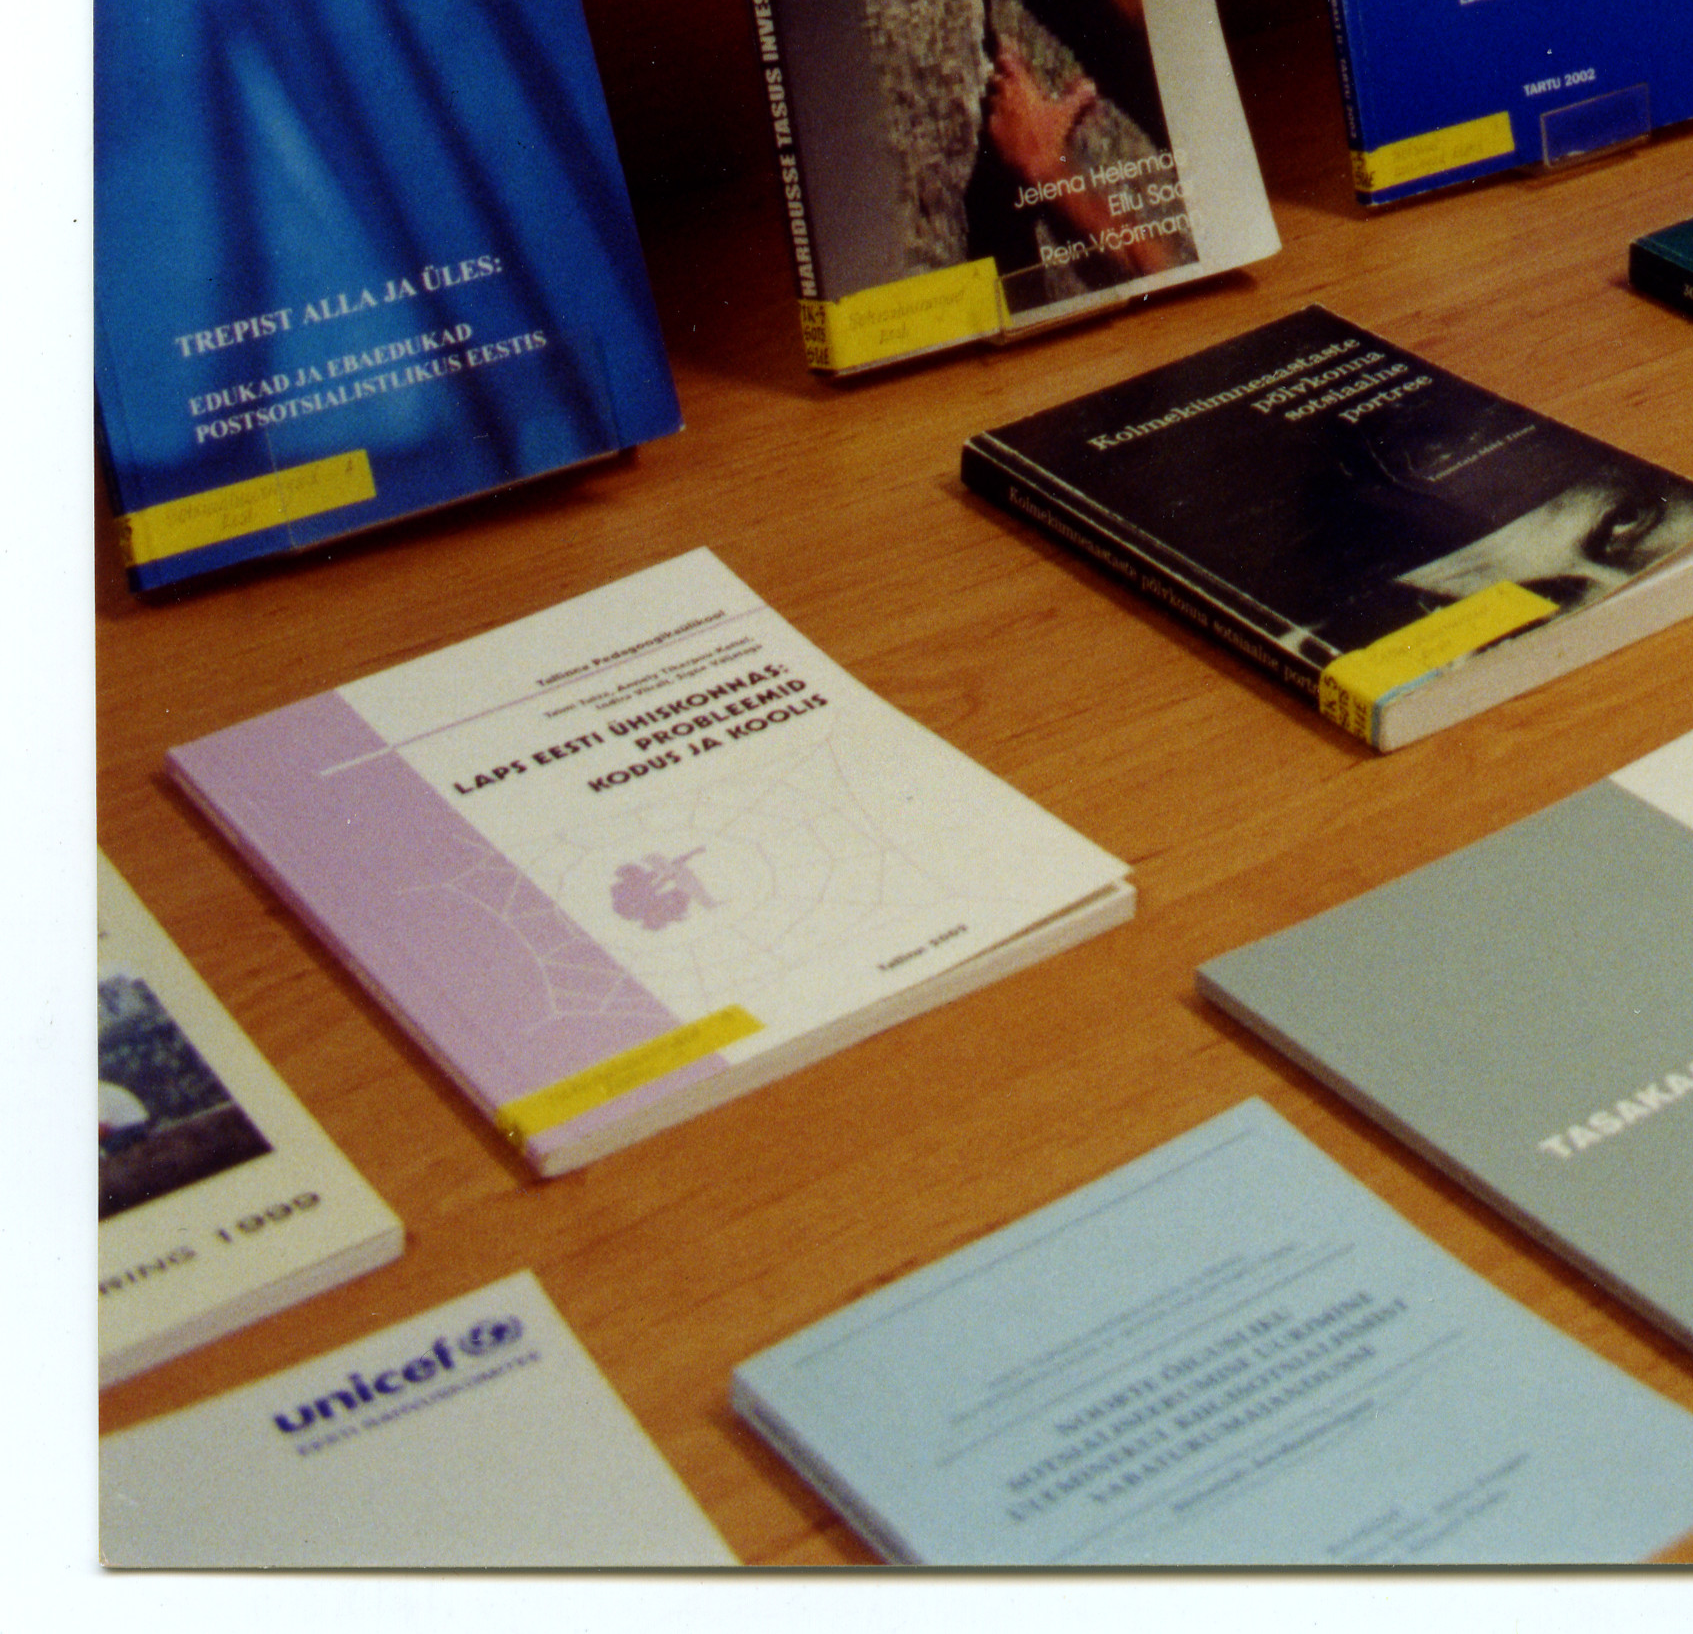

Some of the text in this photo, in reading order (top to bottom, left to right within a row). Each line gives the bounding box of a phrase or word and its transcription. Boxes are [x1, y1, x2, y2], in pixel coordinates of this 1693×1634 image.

[763, 67, 792, 149] TASUS
[1522, 67, 1597, 98] TARTU 2002
[778, 151, 817, 299] HARIDUSSE
[1013, 174, 1086, 209] Jelena
[1107, 188, 1144, 217] Ellu
[175, 254, 504, 359] TREPIST ALLA JA ÜLES:
[187, 322, 474, 417] EDUKAD JA EBAEDUKAD
[194, 329, 549, 445] POSTSOTSIALISTLIKUS EESTIS
[1085, 336, 1362, 451] Kolmekümneaastaste
[1250, 348, 1388, 415] põlvkonna
[1283, 361, 1409, 423] sotsiaalne
[1337, 373, 1434, 425] portree
[452, 759, 528, 796] LAPS
[530, 730, 606, 767] EESTI
[606, 662, 791, 737] ÜHISKONNAS:
[586, 749, 683, 794] KODUS
[686, 736, 724, 757] JA
[724, 692, 830, 740] KOOLIS
[634, 677, 808, 753] PROBLEEMID
[216, 1190, 322, 1244] 1999
[272, 1336, 455, 1435] unicef
